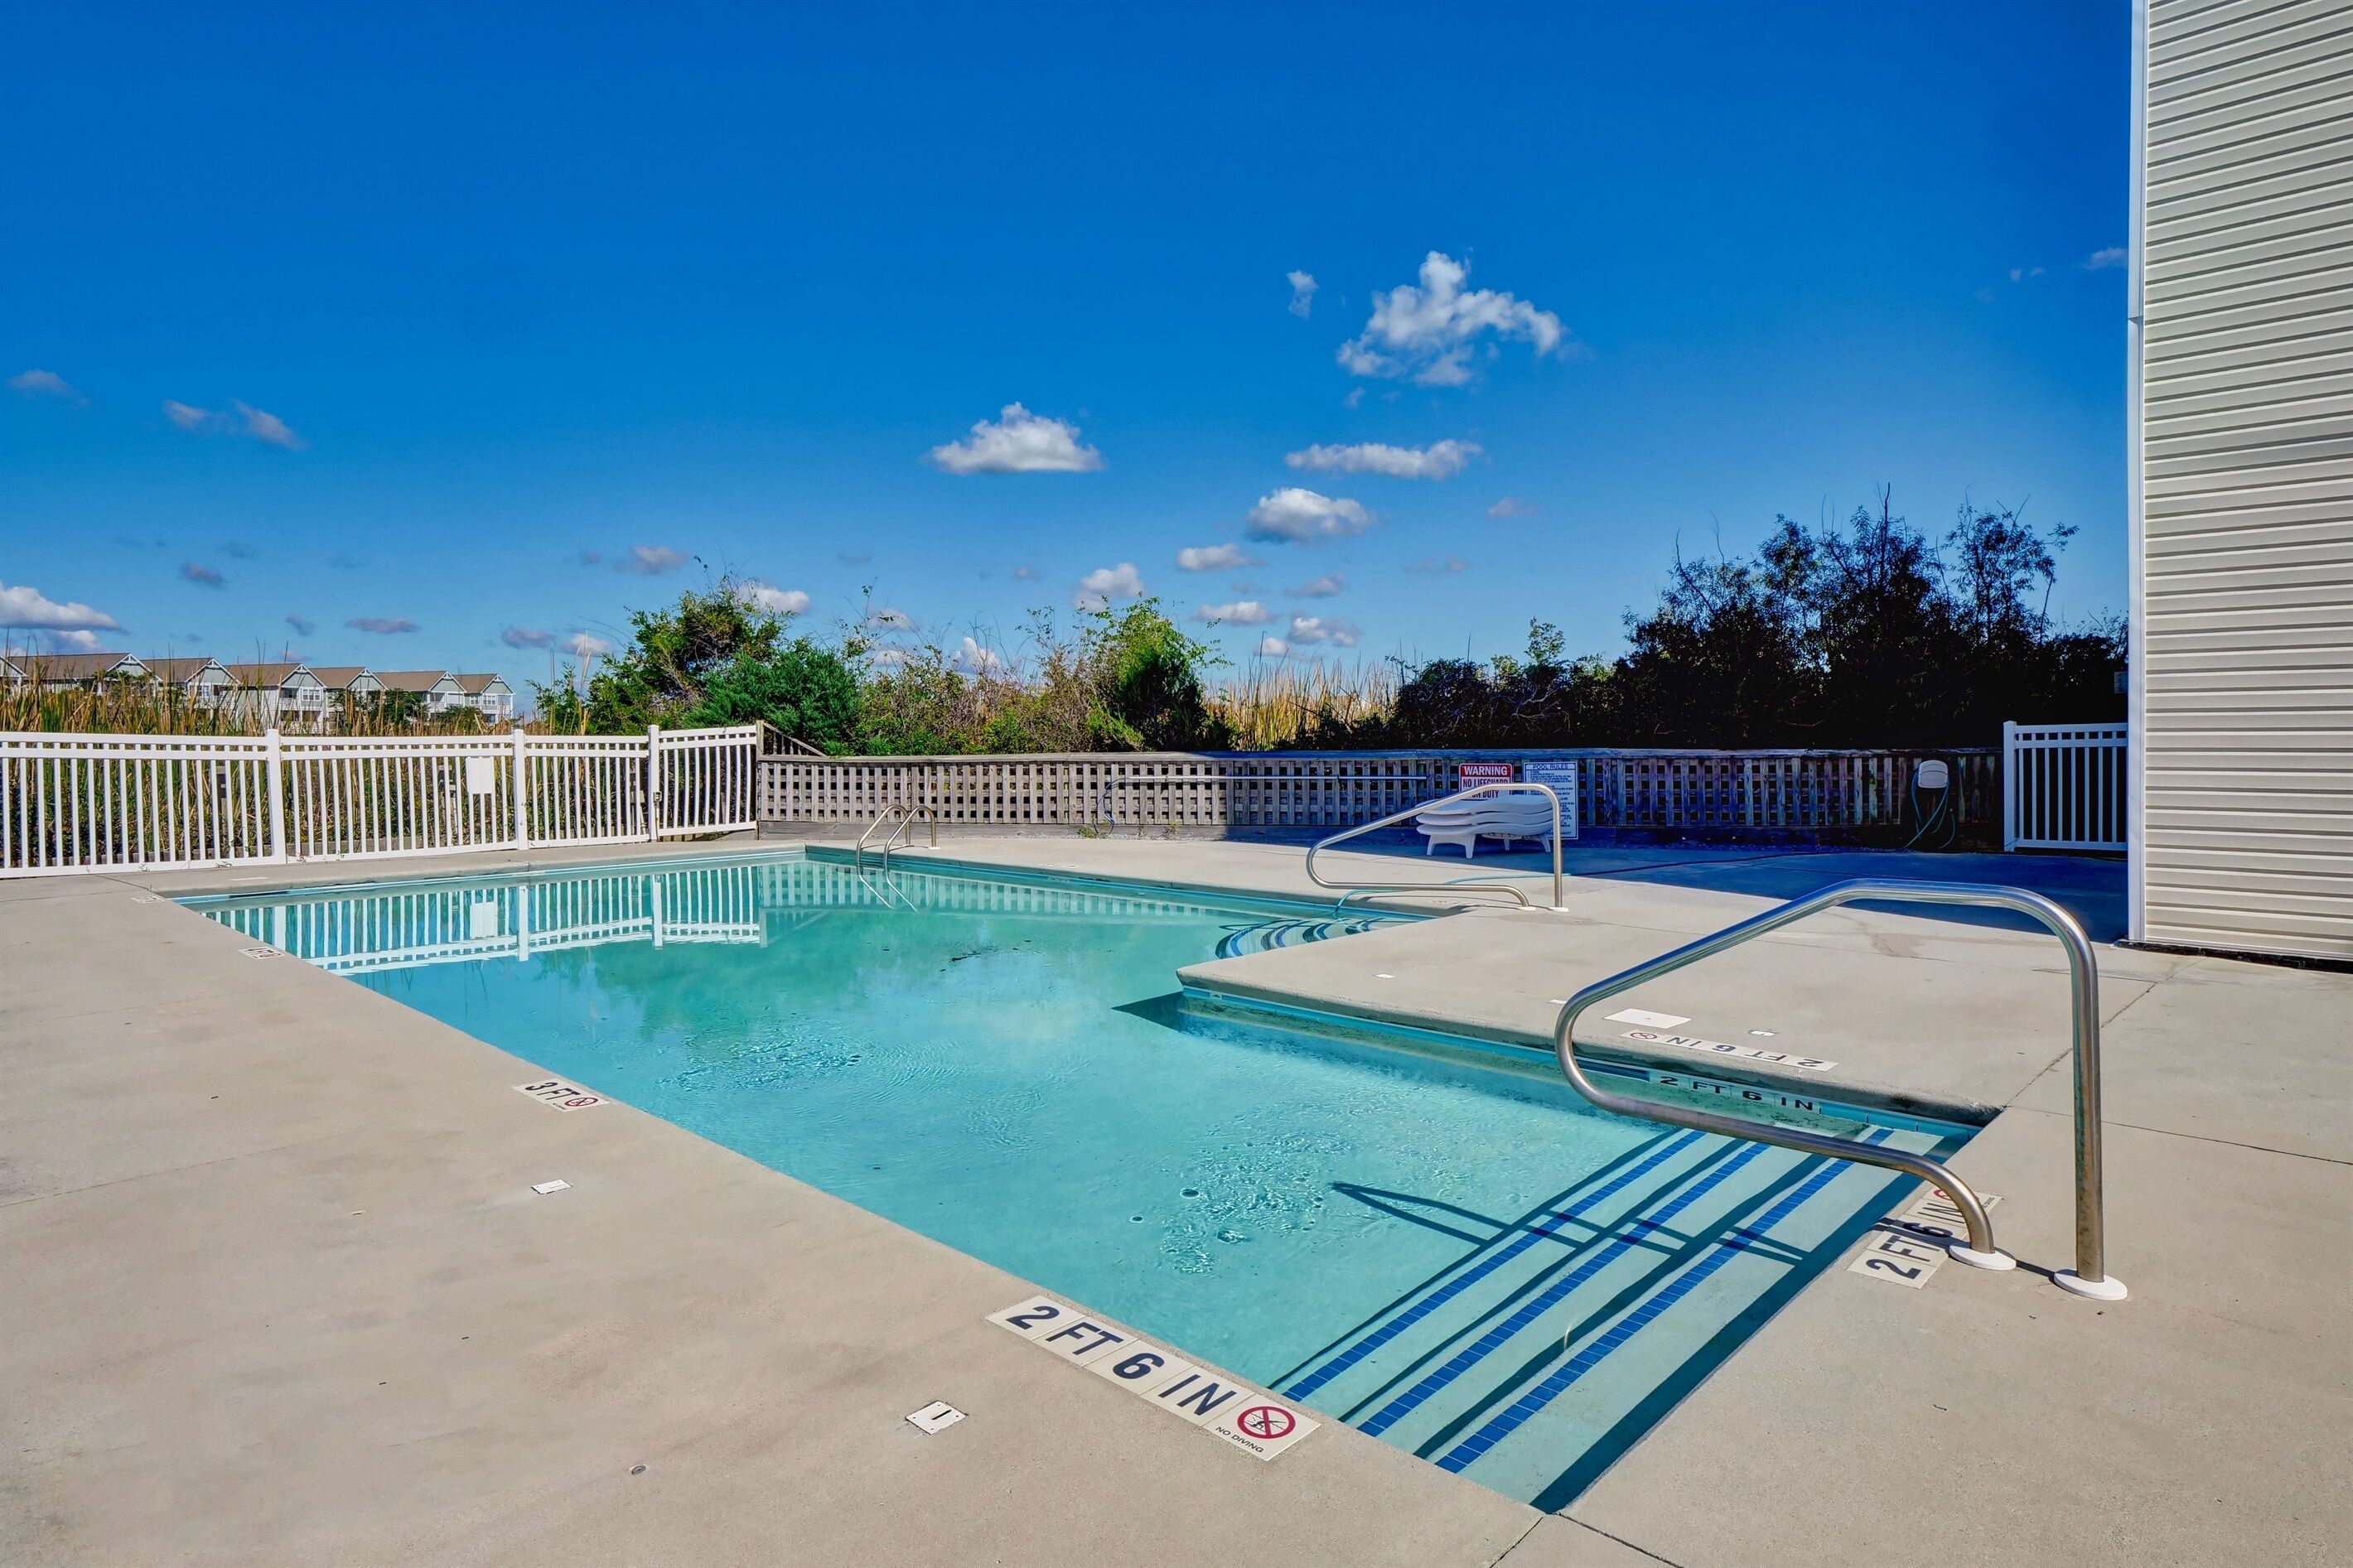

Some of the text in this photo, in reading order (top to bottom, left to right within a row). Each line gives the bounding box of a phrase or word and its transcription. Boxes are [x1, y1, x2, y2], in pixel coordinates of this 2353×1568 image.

[1464, 765, 1508, 775] WARNING
[1463, 779, 1471, 788] NO
[1483, 789, 1499, 798] DUTY
[1665, 1036, 1825, 1068] 2 FT 6 IN
[524, 1082, 582, 1100] 3 FT
[1660, 1076, 1813, 1111] 2 FT 6 IN
[1902, 1222, 1953, 1238] 6
[1879, 1234, 1940, 1262] FT
[1866, 1258, 1922, 1280] 2
[1005, 1305, 1237, 1416] 2 FT 6 IN
[1215, 1426, 1264, 1454] NO DIVING
